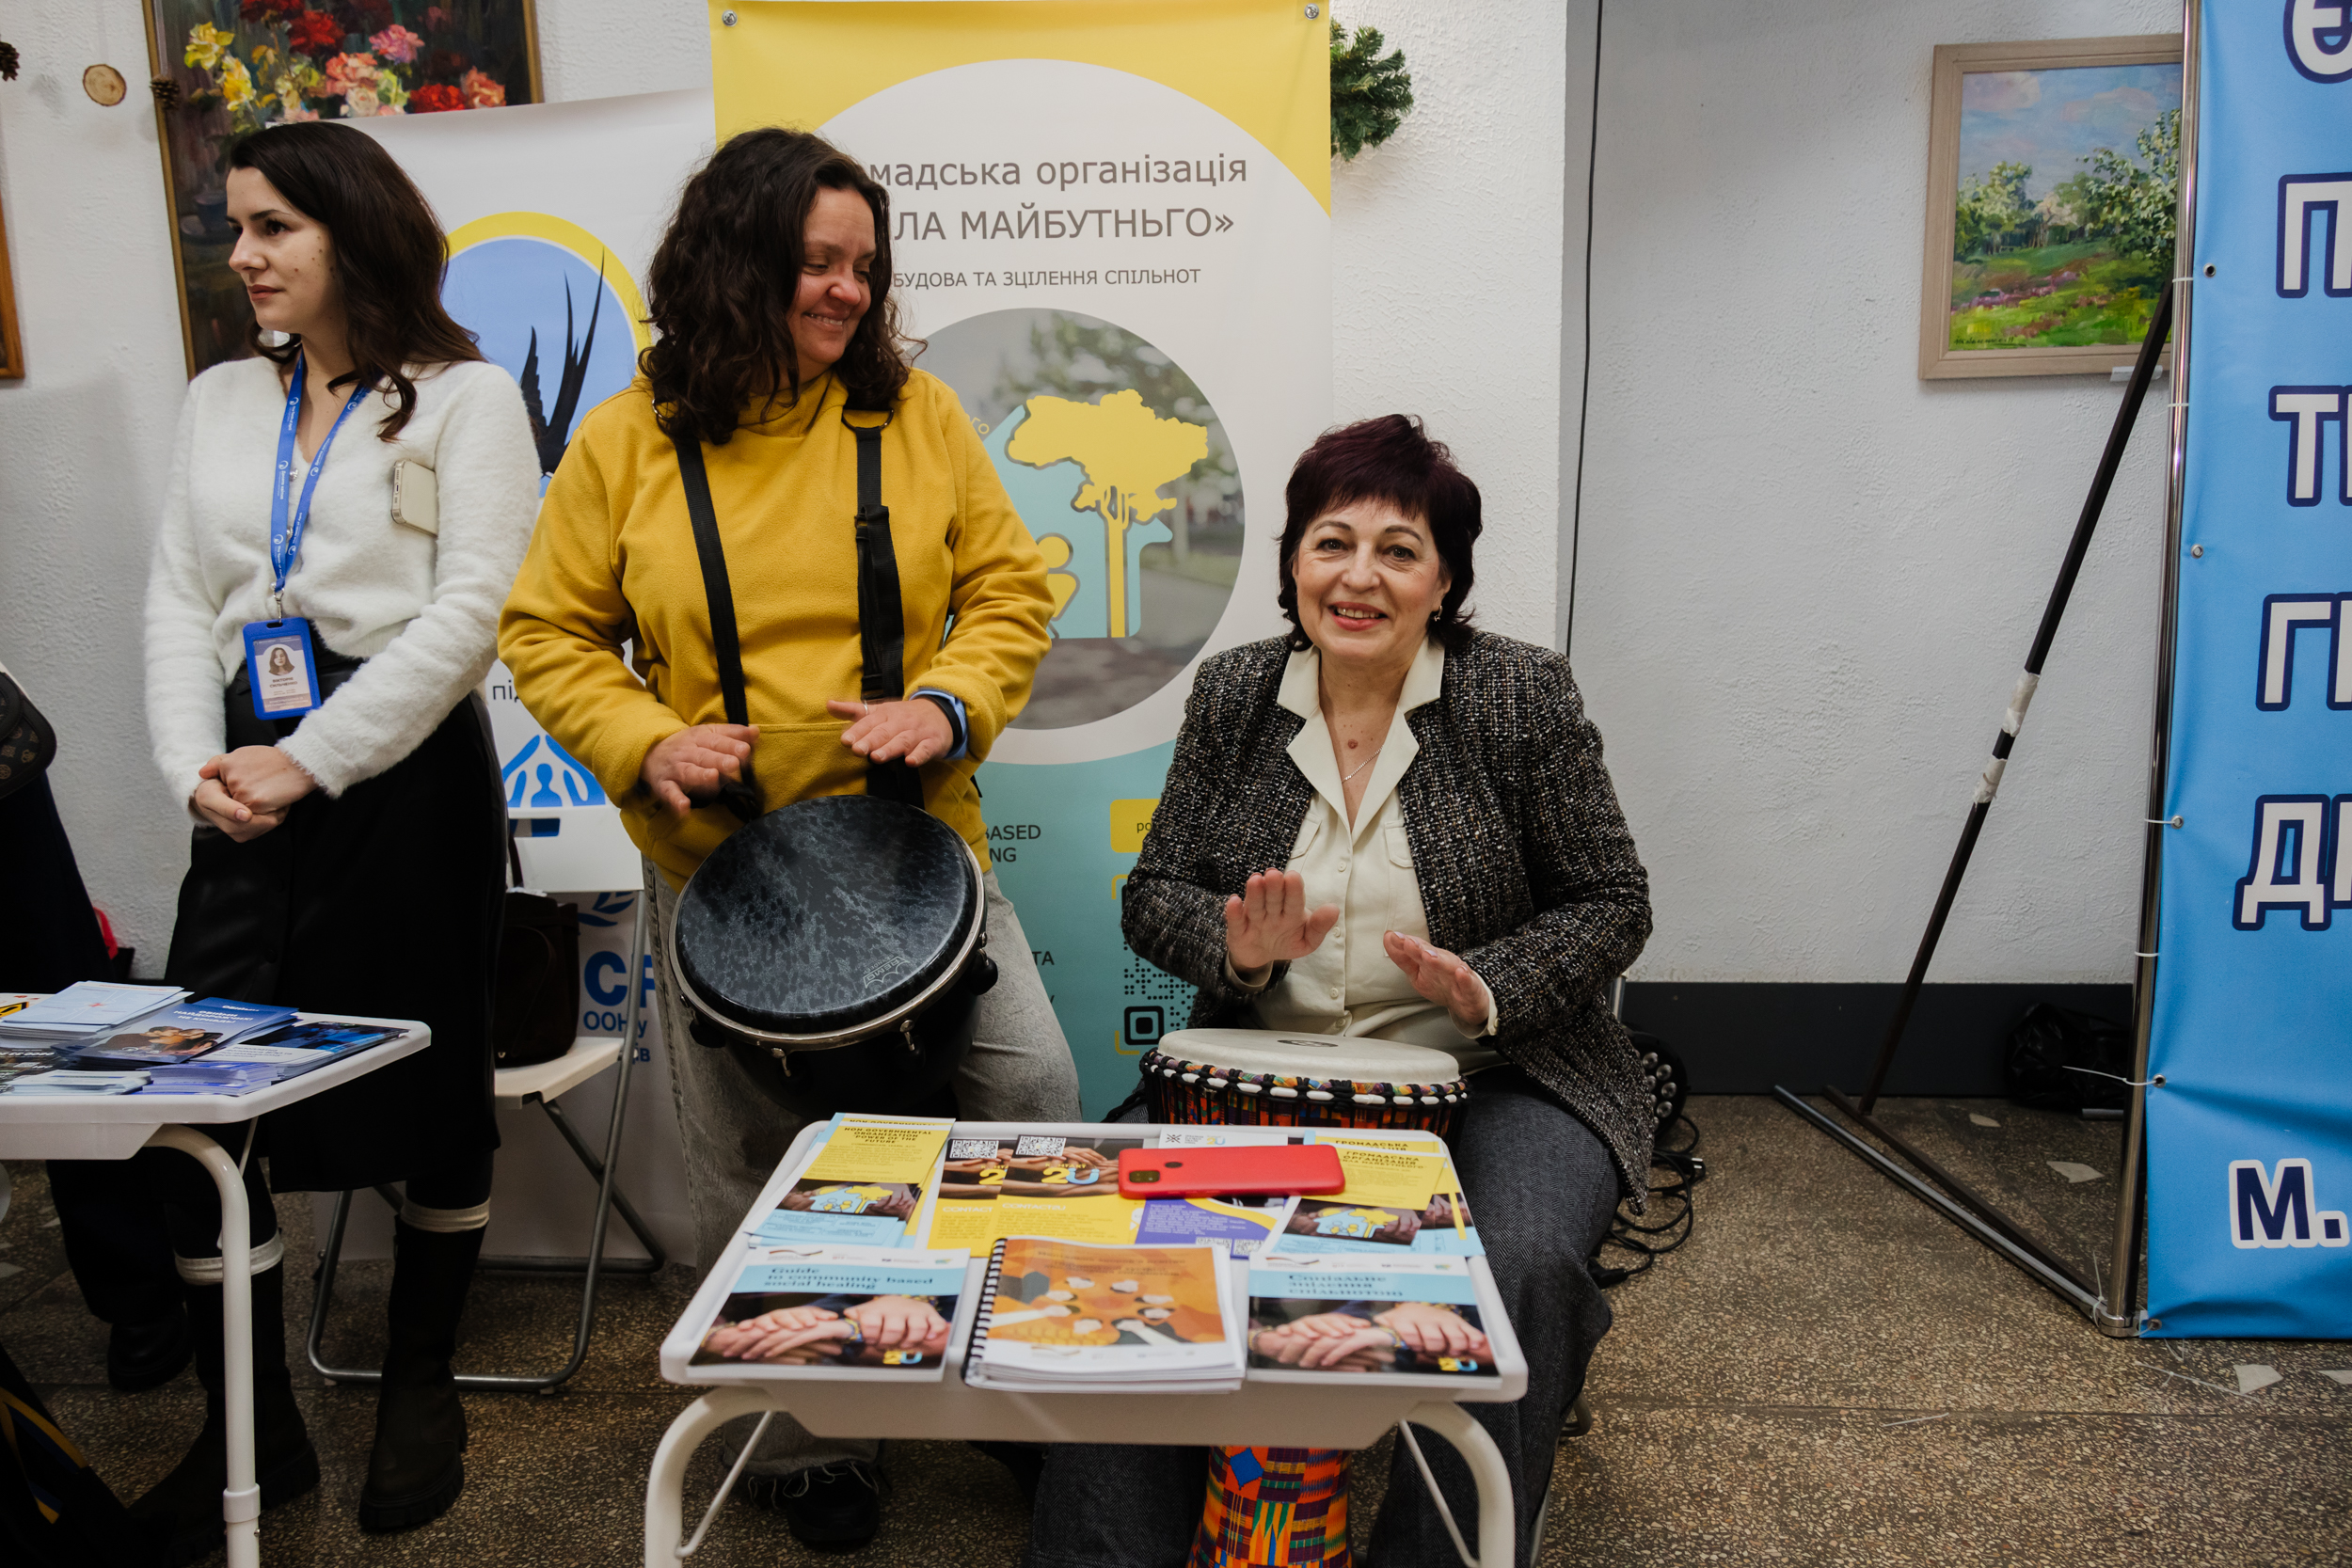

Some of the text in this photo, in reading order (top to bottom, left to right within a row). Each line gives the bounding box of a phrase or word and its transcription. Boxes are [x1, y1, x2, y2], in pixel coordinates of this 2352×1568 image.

[1036, 153, 1248, 192] організація
[961, 201, 1234, 241] МАЙБУТНЬГО»
[973, 271, 997, 287] ТА
[1002, 270, 1099, 290] ЗЦІЛЕННЯ
[1104, 268, 1202, 286] СПІЛЬНОТ
[492, 679, 520, 704] пі
[787, 1275, 882, 1284] community
[816, 1280, 878, 1290] healing
